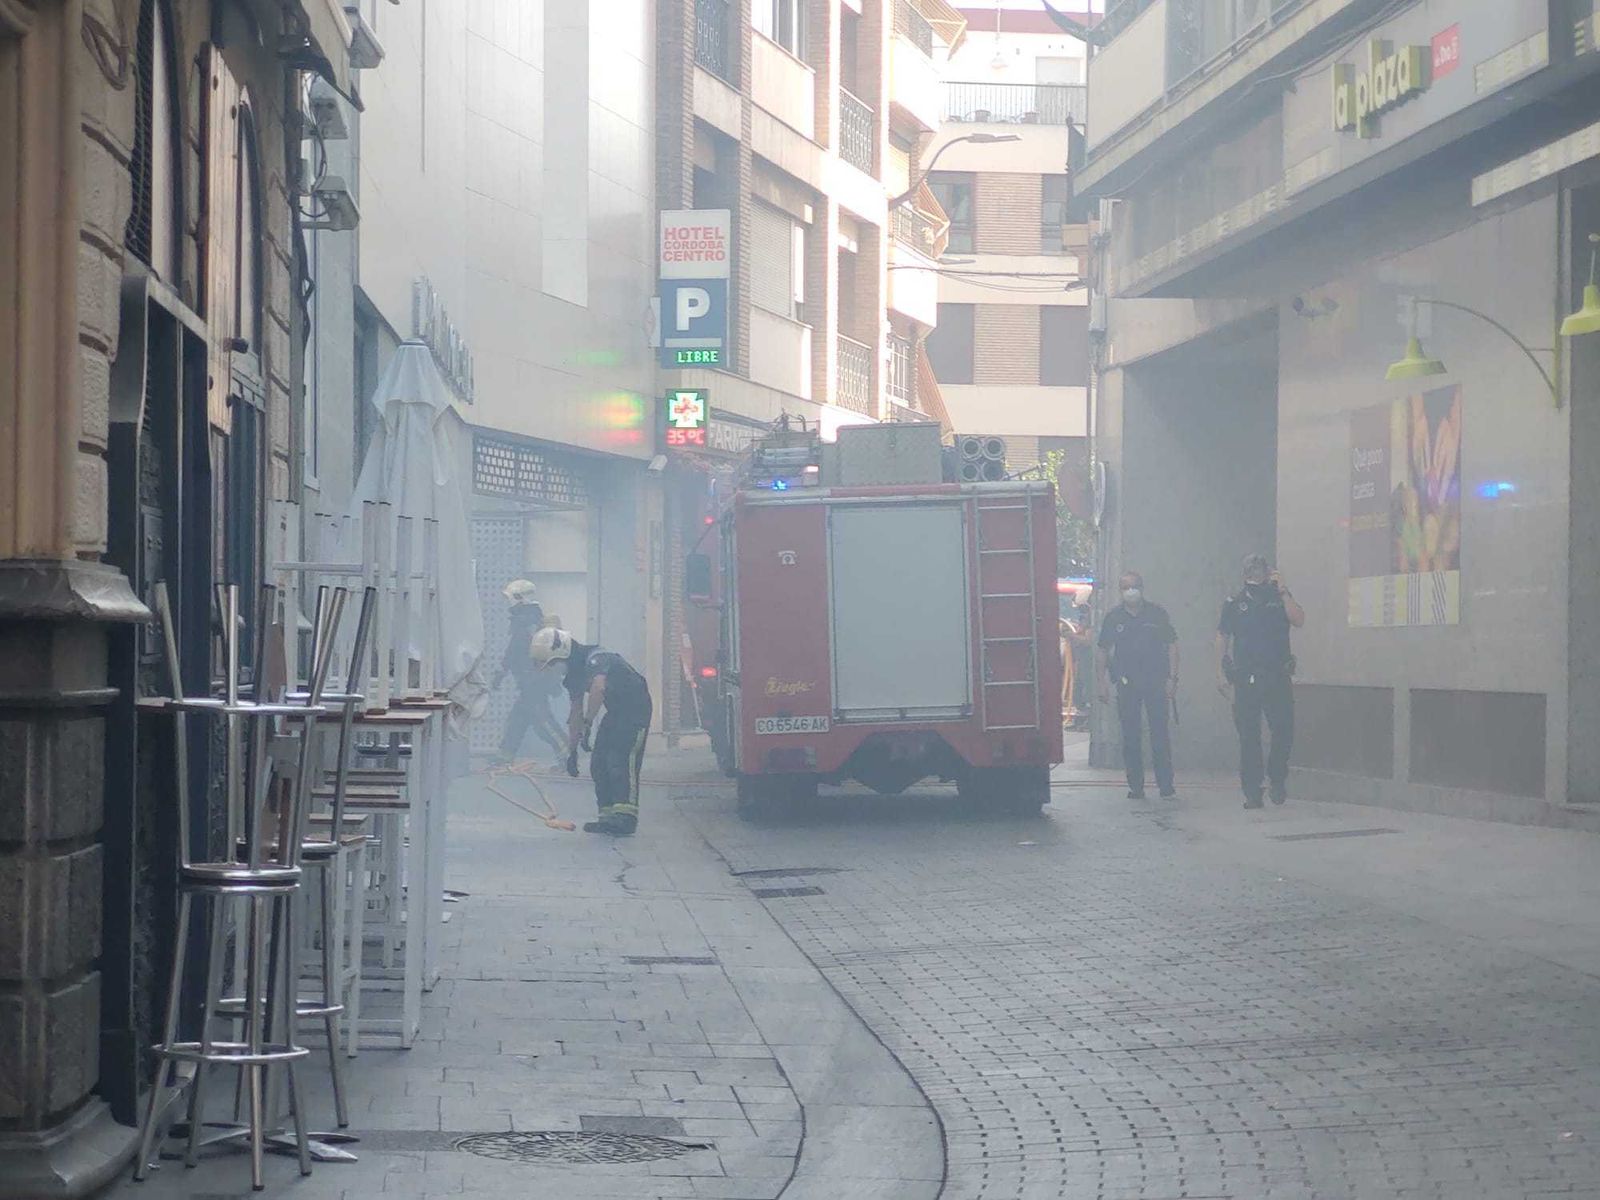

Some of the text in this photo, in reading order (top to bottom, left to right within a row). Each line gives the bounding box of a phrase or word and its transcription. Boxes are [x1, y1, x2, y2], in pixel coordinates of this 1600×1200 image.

[1356, 39, 1414, 138] plaza
[664, 227, 725, 240] HOTEL
[663, 251, 725, 261] CENTRO
[676, 287, 710, 331] P
[677, 351, 719, 363] LIBRE
